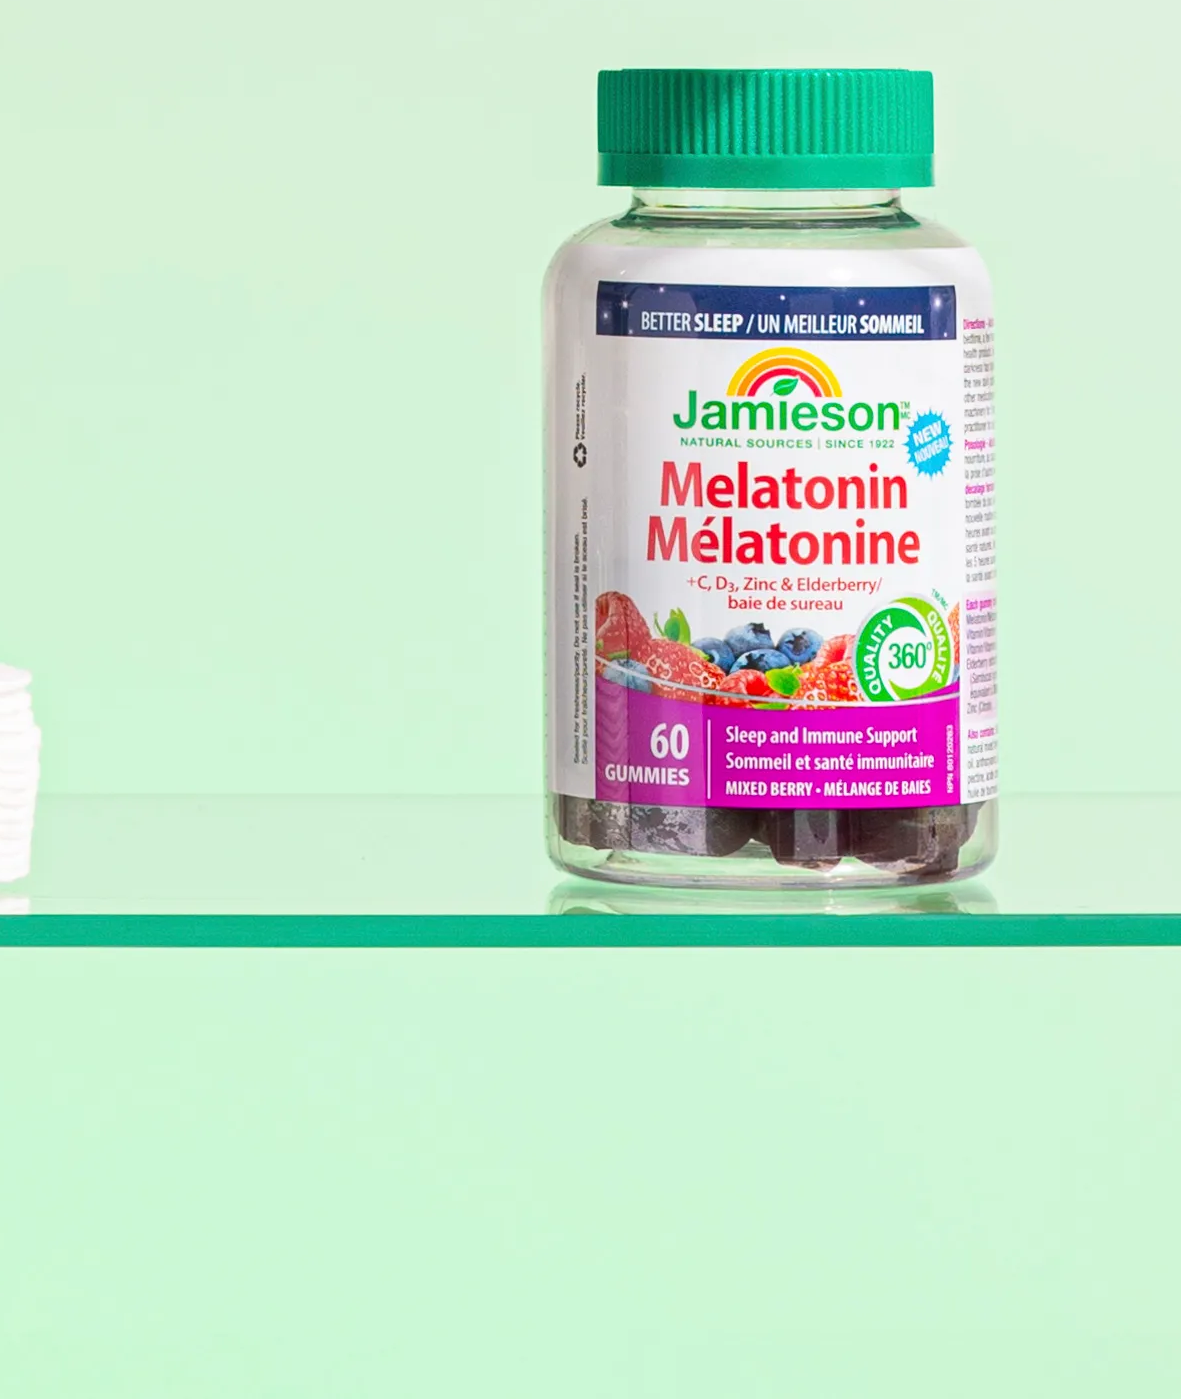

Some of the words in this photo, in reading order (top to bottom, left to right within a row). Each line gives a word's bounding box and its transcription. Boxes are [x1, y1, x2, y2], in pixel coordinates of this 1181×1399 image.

[641, 311, 691, 332] BETTER
[694, 312, 743, 333] SLEEP
[758, 314, 779, 333] UN
[783, 314, 857, 335] MEILLEUR
[859, 314, 924, 335] SOMMEIL
[673, 390, 900, 432] Jamieson
[680, 437, 741, 448] NATURAL
[747, 437, 812, 449] SOURCES
[825, 438, 865, 449] SINCE
[869, 438, 895, 449] 1922
[913, 421, 943, 447] NEW
[914, 433, 949, 462] NOUVEAU
[660, 461, 908, 510] Melatonin
[646, 514, 921, 565] Mélatonine
[687, 576, 712, 595] +C,
[743, 575, 778, 592] Zinc
[782, 576, 794, 592] &
[797, 575, 883, 596] Elderberry/
[727, 594, 761, 610] baie
[764, 594, 786, 610] de
[789, 597, 844, 611] sureau
[869, 614, 895, 695] QUALITY
[887, 641, 933, 670] 360°
[926, 611, 953, 684] QUALITÉ
[650, 723, 690, 760] 60
[726, 726, 765, 746] Sleep
[769, 726, 799, 744] and
[803, 726, 863, 744] Immune
[866, 726, 918, 748] Support
[726, 752, 792, 770] Sommeil
[795, 754, 811, 770] et
[814, 752, 854, 771] santé
[857, 752, 935, 771] immunitaire
[605, 766, 690, 786] GUMMIES
[725, 780, 768, 797] MIXED
[771, 781, 813, 797] BERRY
[823, 777, 881, 797] MÉLANGE
[884, 781, 898, 795] DE
[901, 780, 932, 795] BAIES
[946, 773, 954, 794] NPN
